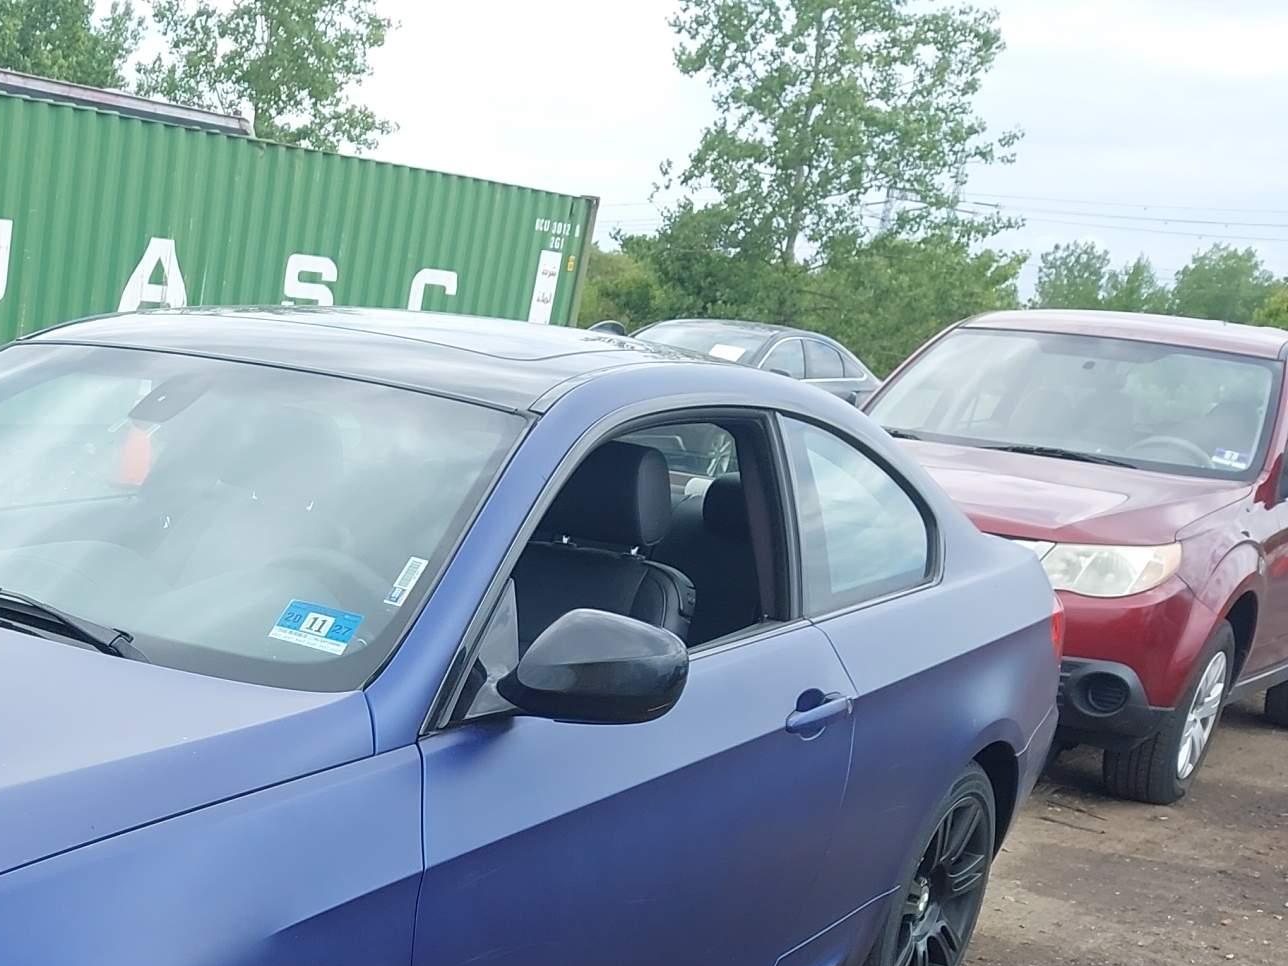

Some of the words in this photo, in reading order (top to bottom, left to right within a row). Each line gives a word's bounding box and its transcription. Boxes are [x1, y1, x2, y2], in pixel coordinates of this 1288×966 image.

[284, 611, 303, 623] 20
[305, 616, 328, 633] 11
[331, 624, 353, 636] 27
